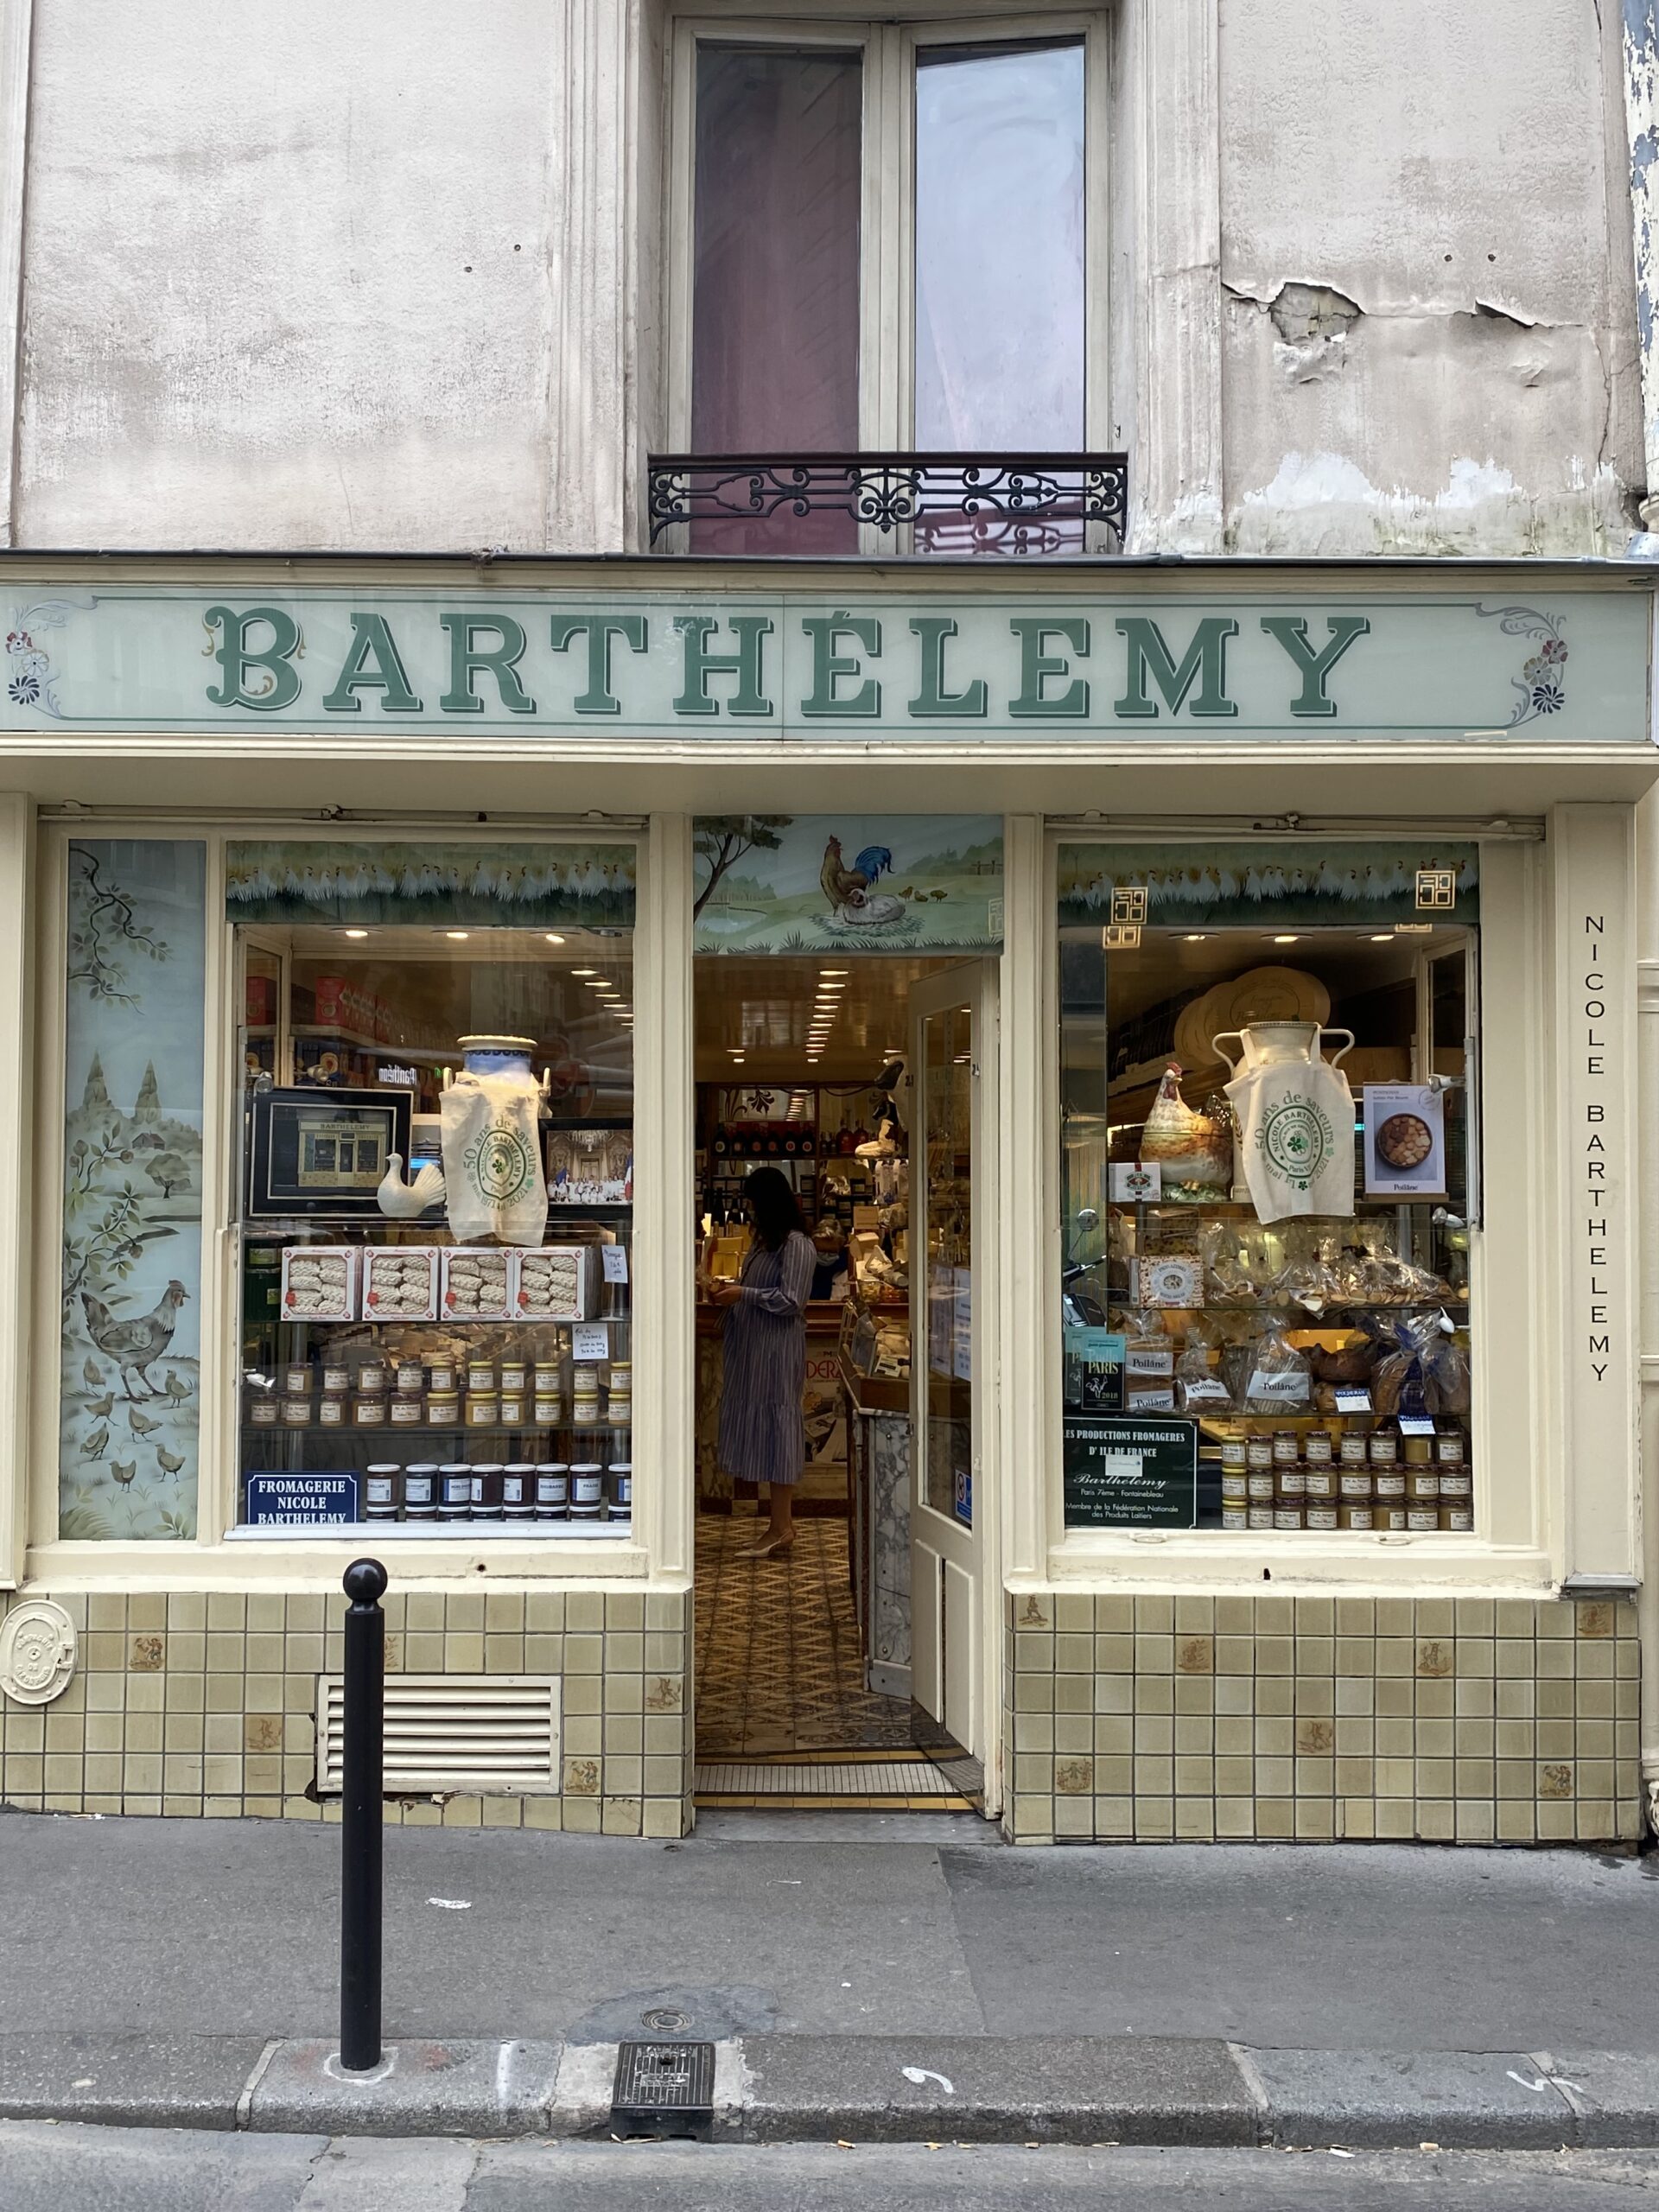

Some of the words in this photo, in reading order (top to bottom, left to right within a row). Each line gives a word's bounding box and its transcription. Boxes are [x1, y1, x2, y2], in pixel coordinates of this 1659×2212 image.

[1585, 915, 1605, 1075] NICOLE
[1283, 1090, 1302, 1105] de
[1305, 1097, 1334, 1144] saveurs
[1272, 1119, 1284, 1153] NICOLE
[463, 1148, 477, 1169] 50
[474, 1124, 491, 1147] ans
[495, 1114, 511, 1129] de
[513, 1127, 537, 1176] saveurs
[1586, 1104, 1611, 1382] BARTHELEMY
[1088, 1362, 1119, 1374] PARIS
[1133, 1357, 1166, 1368] Poilâne
[1077, 1430, 1131, 1440] PRODUCTIONS
[1133, 1431, 1185, 1442] FROMAGERES
[1089, 1446, 1097, 1455] D'
[1127, 1447, 1157, 1458] FRANCE
[258, 1480, 346, 1493] FROMAGERIE
[277, 1497, 327, 1510] NICOLE
[1113, 1503, 1145, 1512] Fédération
[1147, 1504, 1179, 1513] Nationale
[257, 1513, 346, 1524] BARTHELEMY
